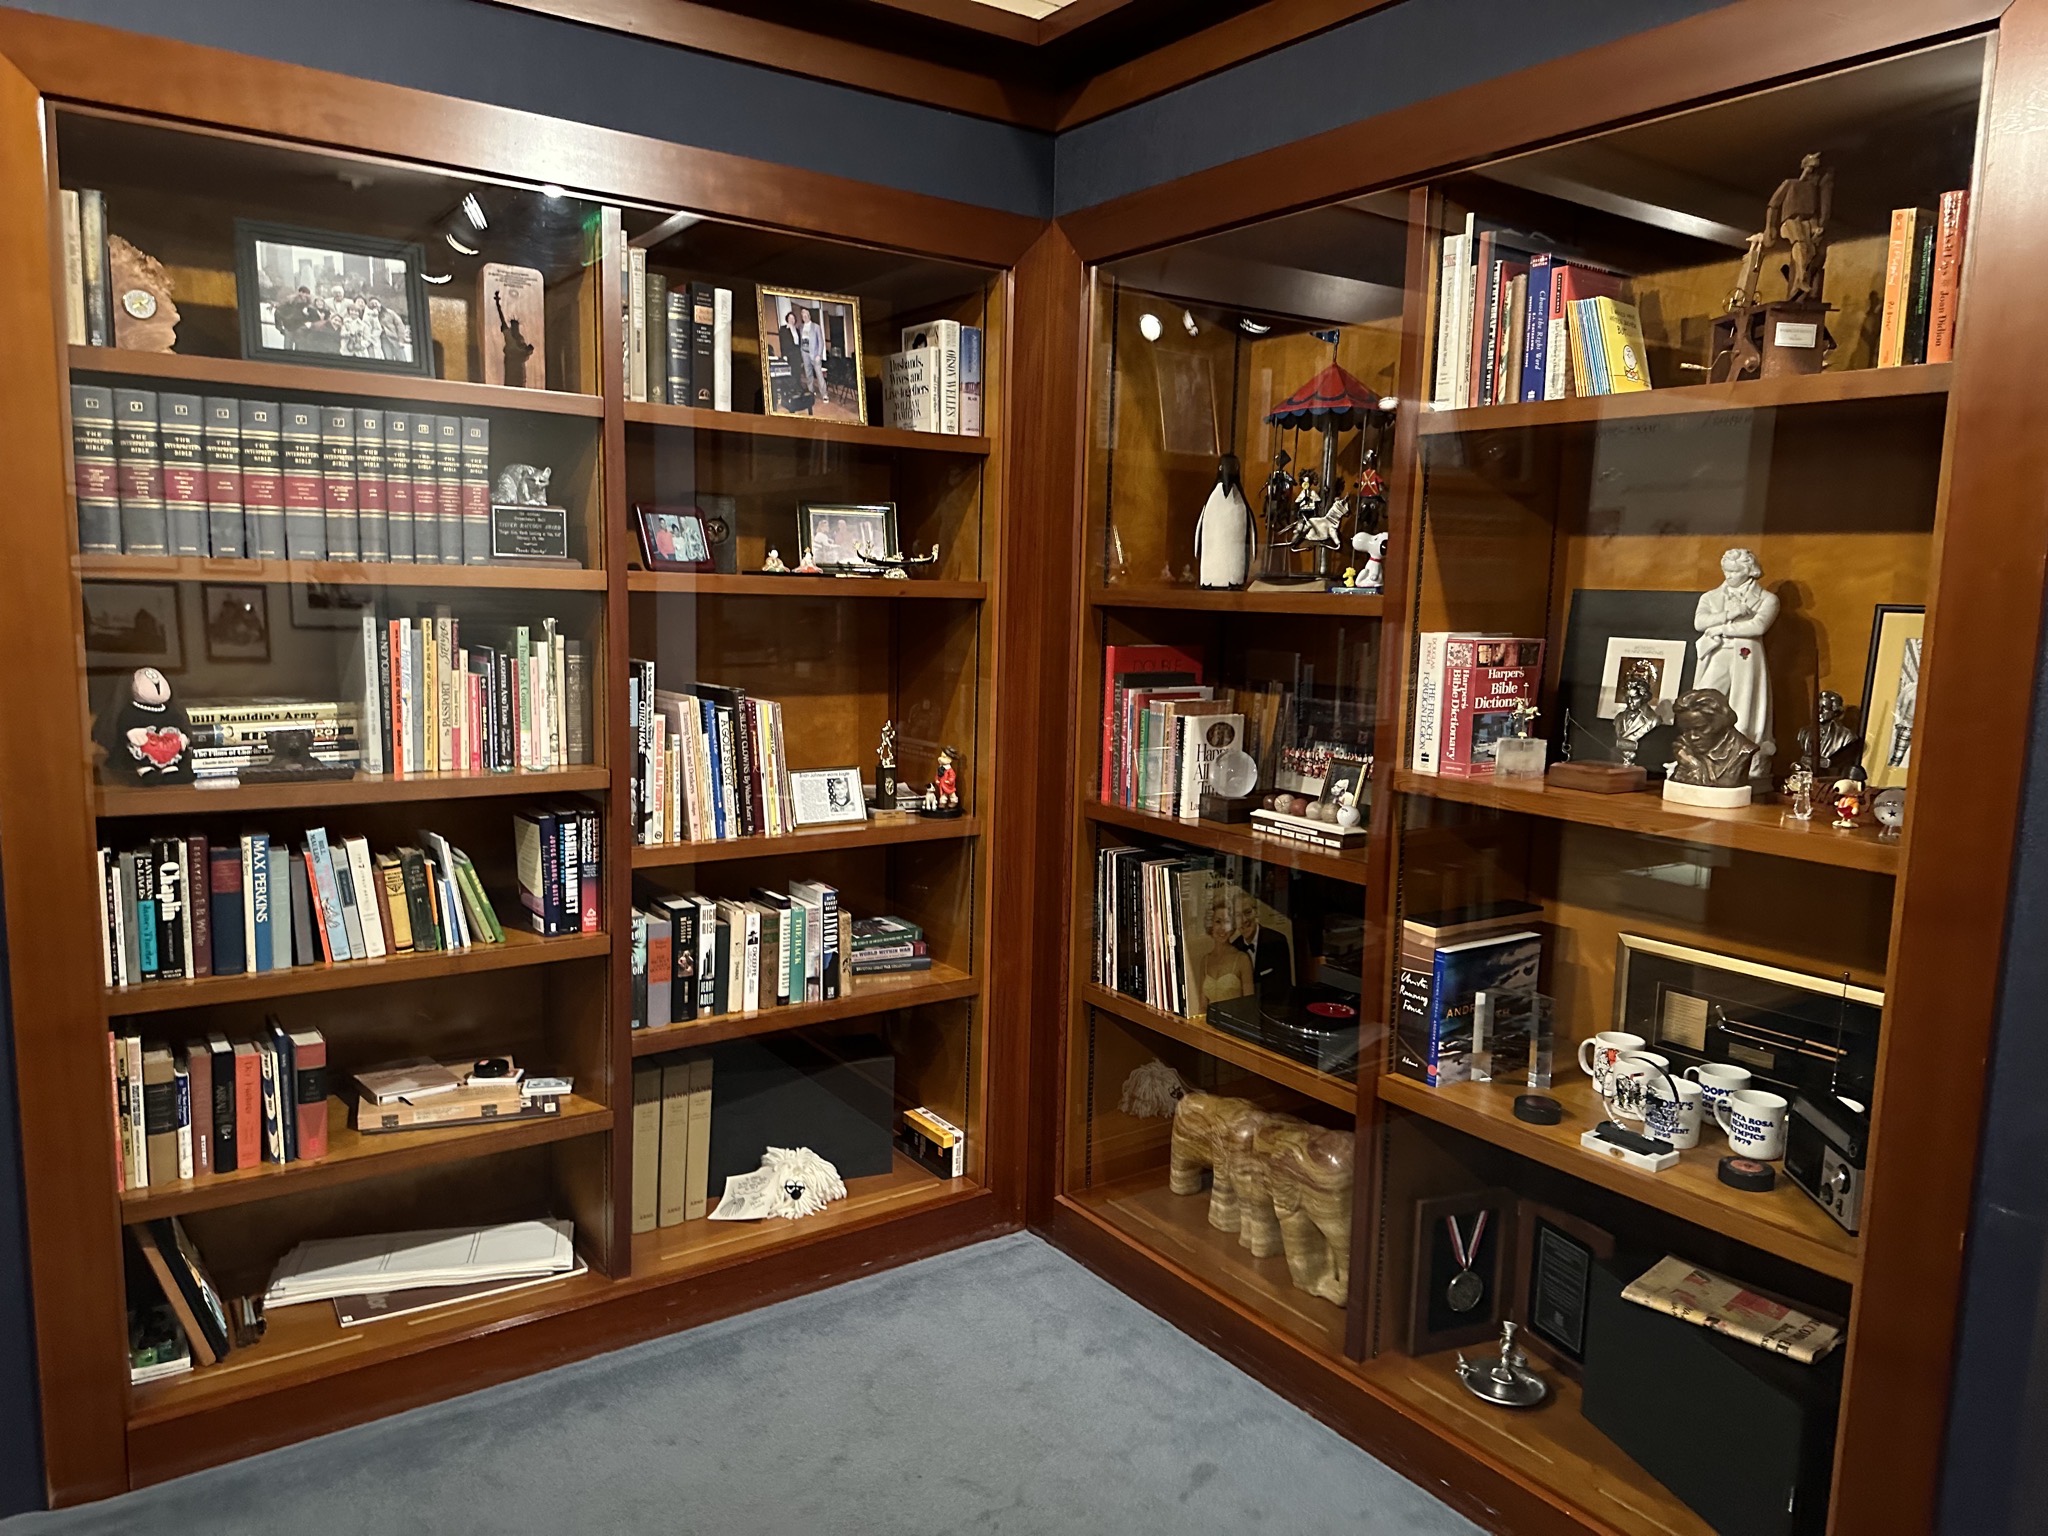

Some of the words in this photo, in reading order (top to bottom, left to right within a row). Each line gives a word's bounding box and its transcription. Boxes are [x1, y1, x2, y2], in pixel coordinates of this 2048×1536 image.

[1538, 290, 1546, 315] Choose
[1938, 291, 1948, 313] Joan
[1537, 318, 1545, 329] the
[1935, 315, 1946, 347] Didion
[1534, 332, 1543, 350] Right
[946, 350, 957, 377] ORSON
[1534, 352, 1543, 370] Word
[910, 369, 922, 382] and
[945, 381, 957, 417] WELLES
[174, 449, 193, 457] BIBLE
[332, 460, 349, 468] BIBLE
[500, 654, 508, 688] LAUGHTER
[520, 644, 528, 676] Thurber
[1452, 669, 1462, 698] Bible
[1488, 667, 1525, 681] Harper's
[501, 690, 509, 704] AND
[1114, 680, 1122, 705] THE
[1421, 671, 1430, 712] FOREIGN
[1428, 682, 1436, 700] THE
[1460, 669, 1470, 709] Harper's
[1490, 681, 1518, 695] Bible
[442, 681, 451, 727] PASSPORT
[501, 704, 509, 725] TEARS
[520, 687, 529, 725] Company
[738, 695, 746, 712] THE
[192, 714, 215, 724] Bill
[220, 712, 280, 723] Mauldin's
[284, 711, 319, 721] Army
[683, 711, 691, 735] Training
[720, 719, 728, 727] A
[739, 713, 748, 740] SILENT
[1113, 710, 1121, 749] GREAT
[1426, 703, 1435, 741] FRENCH
[1446, 699, 1460, 760] Dictionary
[656, 720, 664, 758] HERBLOCK
[721, 727, 731, 754] GOLF
[1419, 715, 1428, 749] LEGION
[684, 736, 692, 755] Mules
[740, 741, 750, 774] CLOWNS
[656, 759, 663, 768] ON
[723, 756, 733, 786] STORY
[1112, 751, 1120, 795] GATSBY
[1193, 763, 1210, 781] All
[687, 768, 696, 794] Donkeys
[655, 783, 663, 812] FRONTS
[744, 784, 752, 805] Walter
[745, 805, 753, 821] Kerr
[727, 817, 735, 835] Price
[254, 840, 267, 870] MAX
[550, 835, 558, 857] JOYCE
[564, 822, 578, 867] DASHIELL
[193, 846, 202, 880] ESSAYS
[156, 862, 182, 922] Chaplin
[195, 884, 203, 895] OF
[254, 873, 268, 923] PERKINS
[552, 884, 560, 906] OATES
[564, 867, 578, 914] HAMMETT
[143, 904, 152, 930] James
[702, 909, 716, 921] HIGH
[197, 919, 207, 946] White
[702, 922, 716, 935] RISE
[795, 918, 803, 938] THE
[823, 912, 838, 954] LINCOLN
[145, 932, 154, 965] Thurber
[794, 940, 802, 964] HACK
[700, 980, 715, 993] JERRY
[1399, 985, 1428, 1007] Running
[699, 993, 714, 1005] ADLER
[1402, 1000, 1424, 1015] Fence
[1730, 1125, 1766, 1142] LYMPICS
[1732, 1118, 1761, 1133] SENIOR
[1748, 1116, 1774, 1128] ROSA
[1734, 1135, 1752, 1146] 1979
